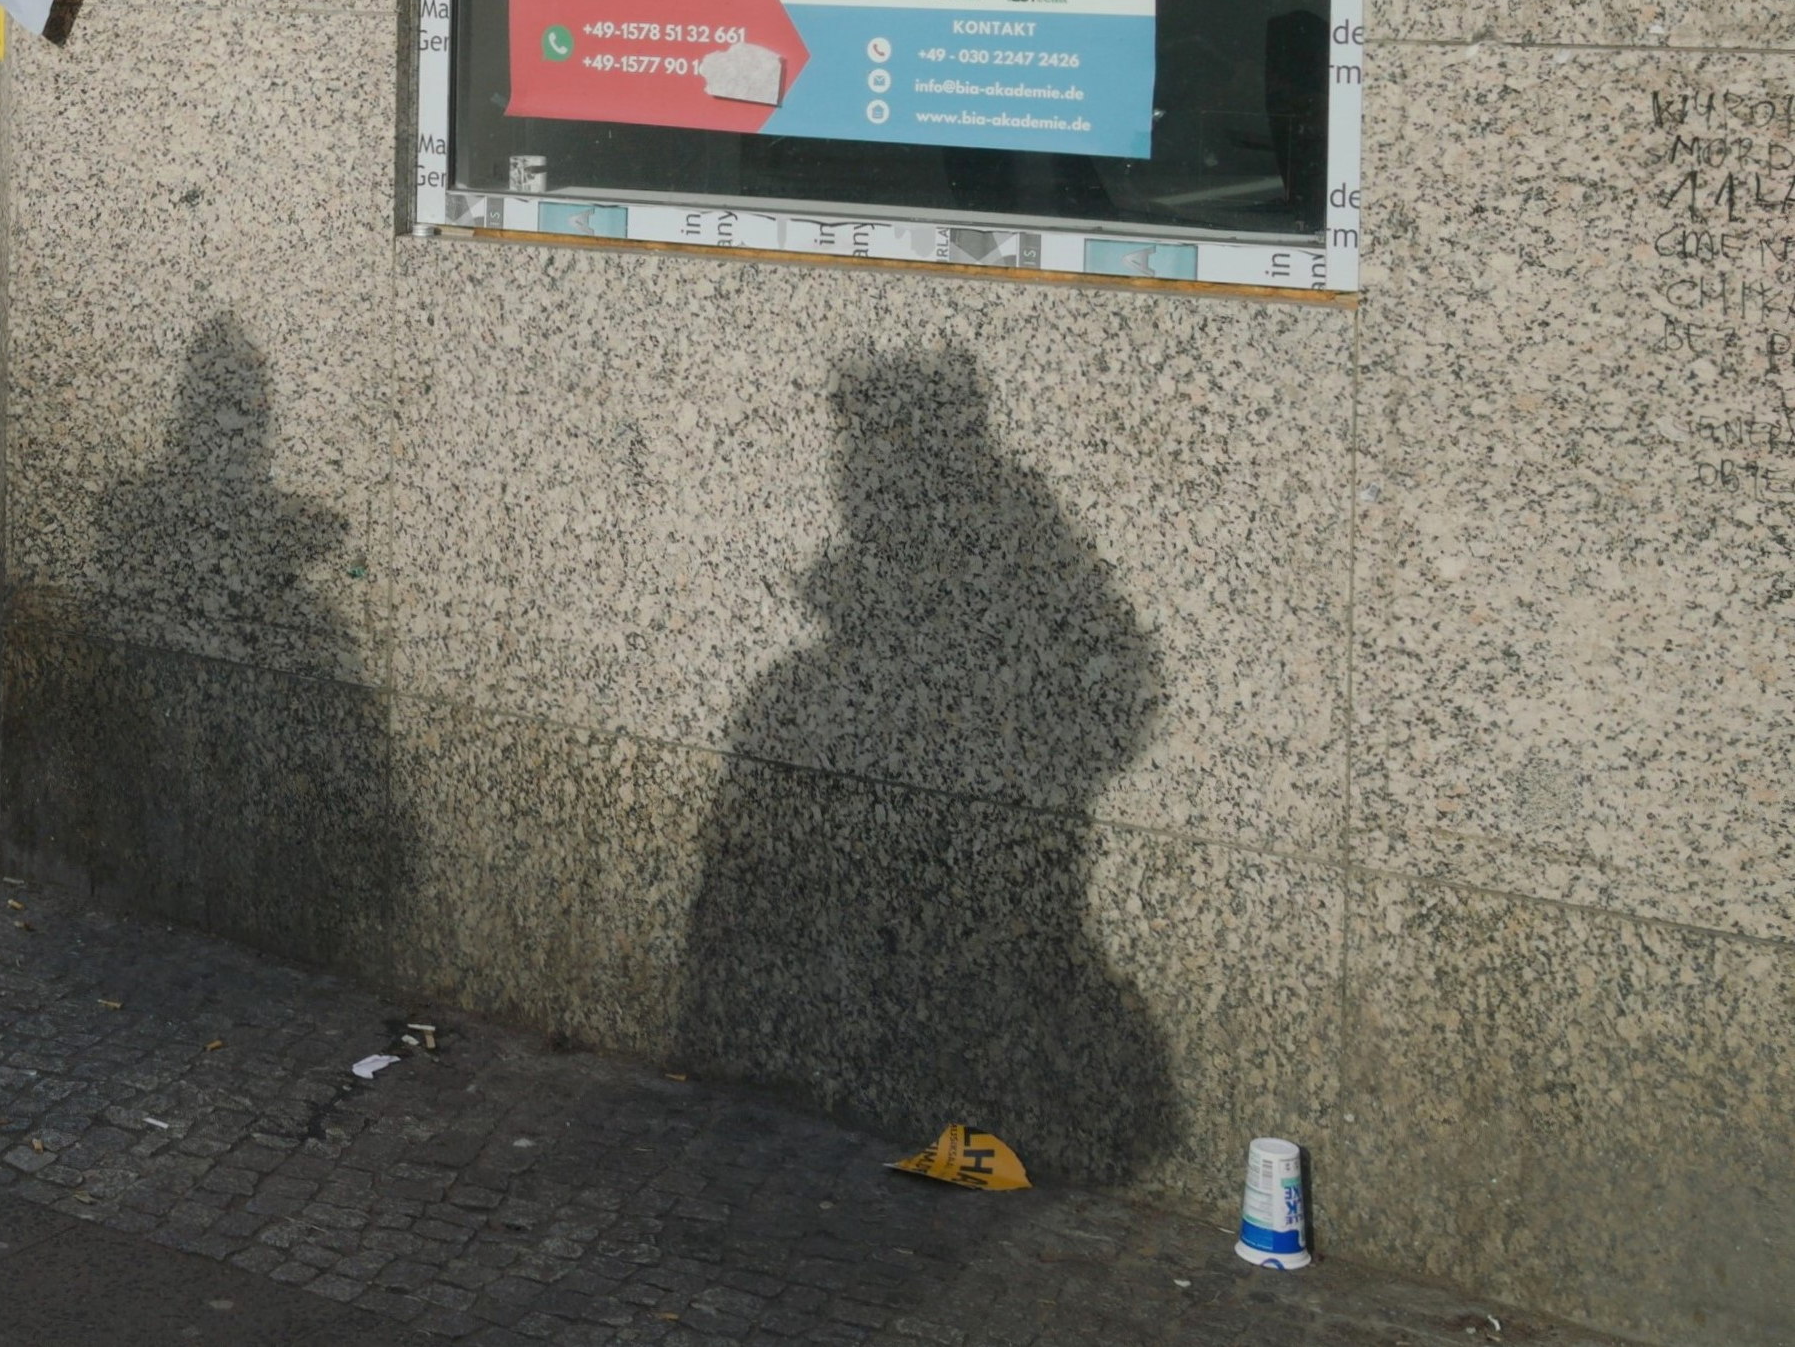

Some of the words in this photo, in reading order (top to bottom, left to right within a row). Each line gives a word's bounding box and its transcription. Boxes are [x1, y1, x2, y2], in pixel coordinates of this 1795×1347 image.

[583, 22, 660, 41] +49-1578
[665, 25, 682, 41] 51
[687, 25, 710, 42] 32
[715, 27, 745, 43] 661
[953, 20, 1037, 37] KONTAKT
[583, 54, 661, 73] +49-1577
[665, 58, 687, 74] 90
[918, 48, 946, 62] +49
[959, 49, 989, 64] 030
[993, 50, 1033, 66] 2247
[1038, 52, 1080, 68] 2426
[915, 78, 1084, 101] info@bia-akademie.de
[916, 110, 1092, 132] www.bia-akademie.de
[1266, 252, 1290, 278] in
